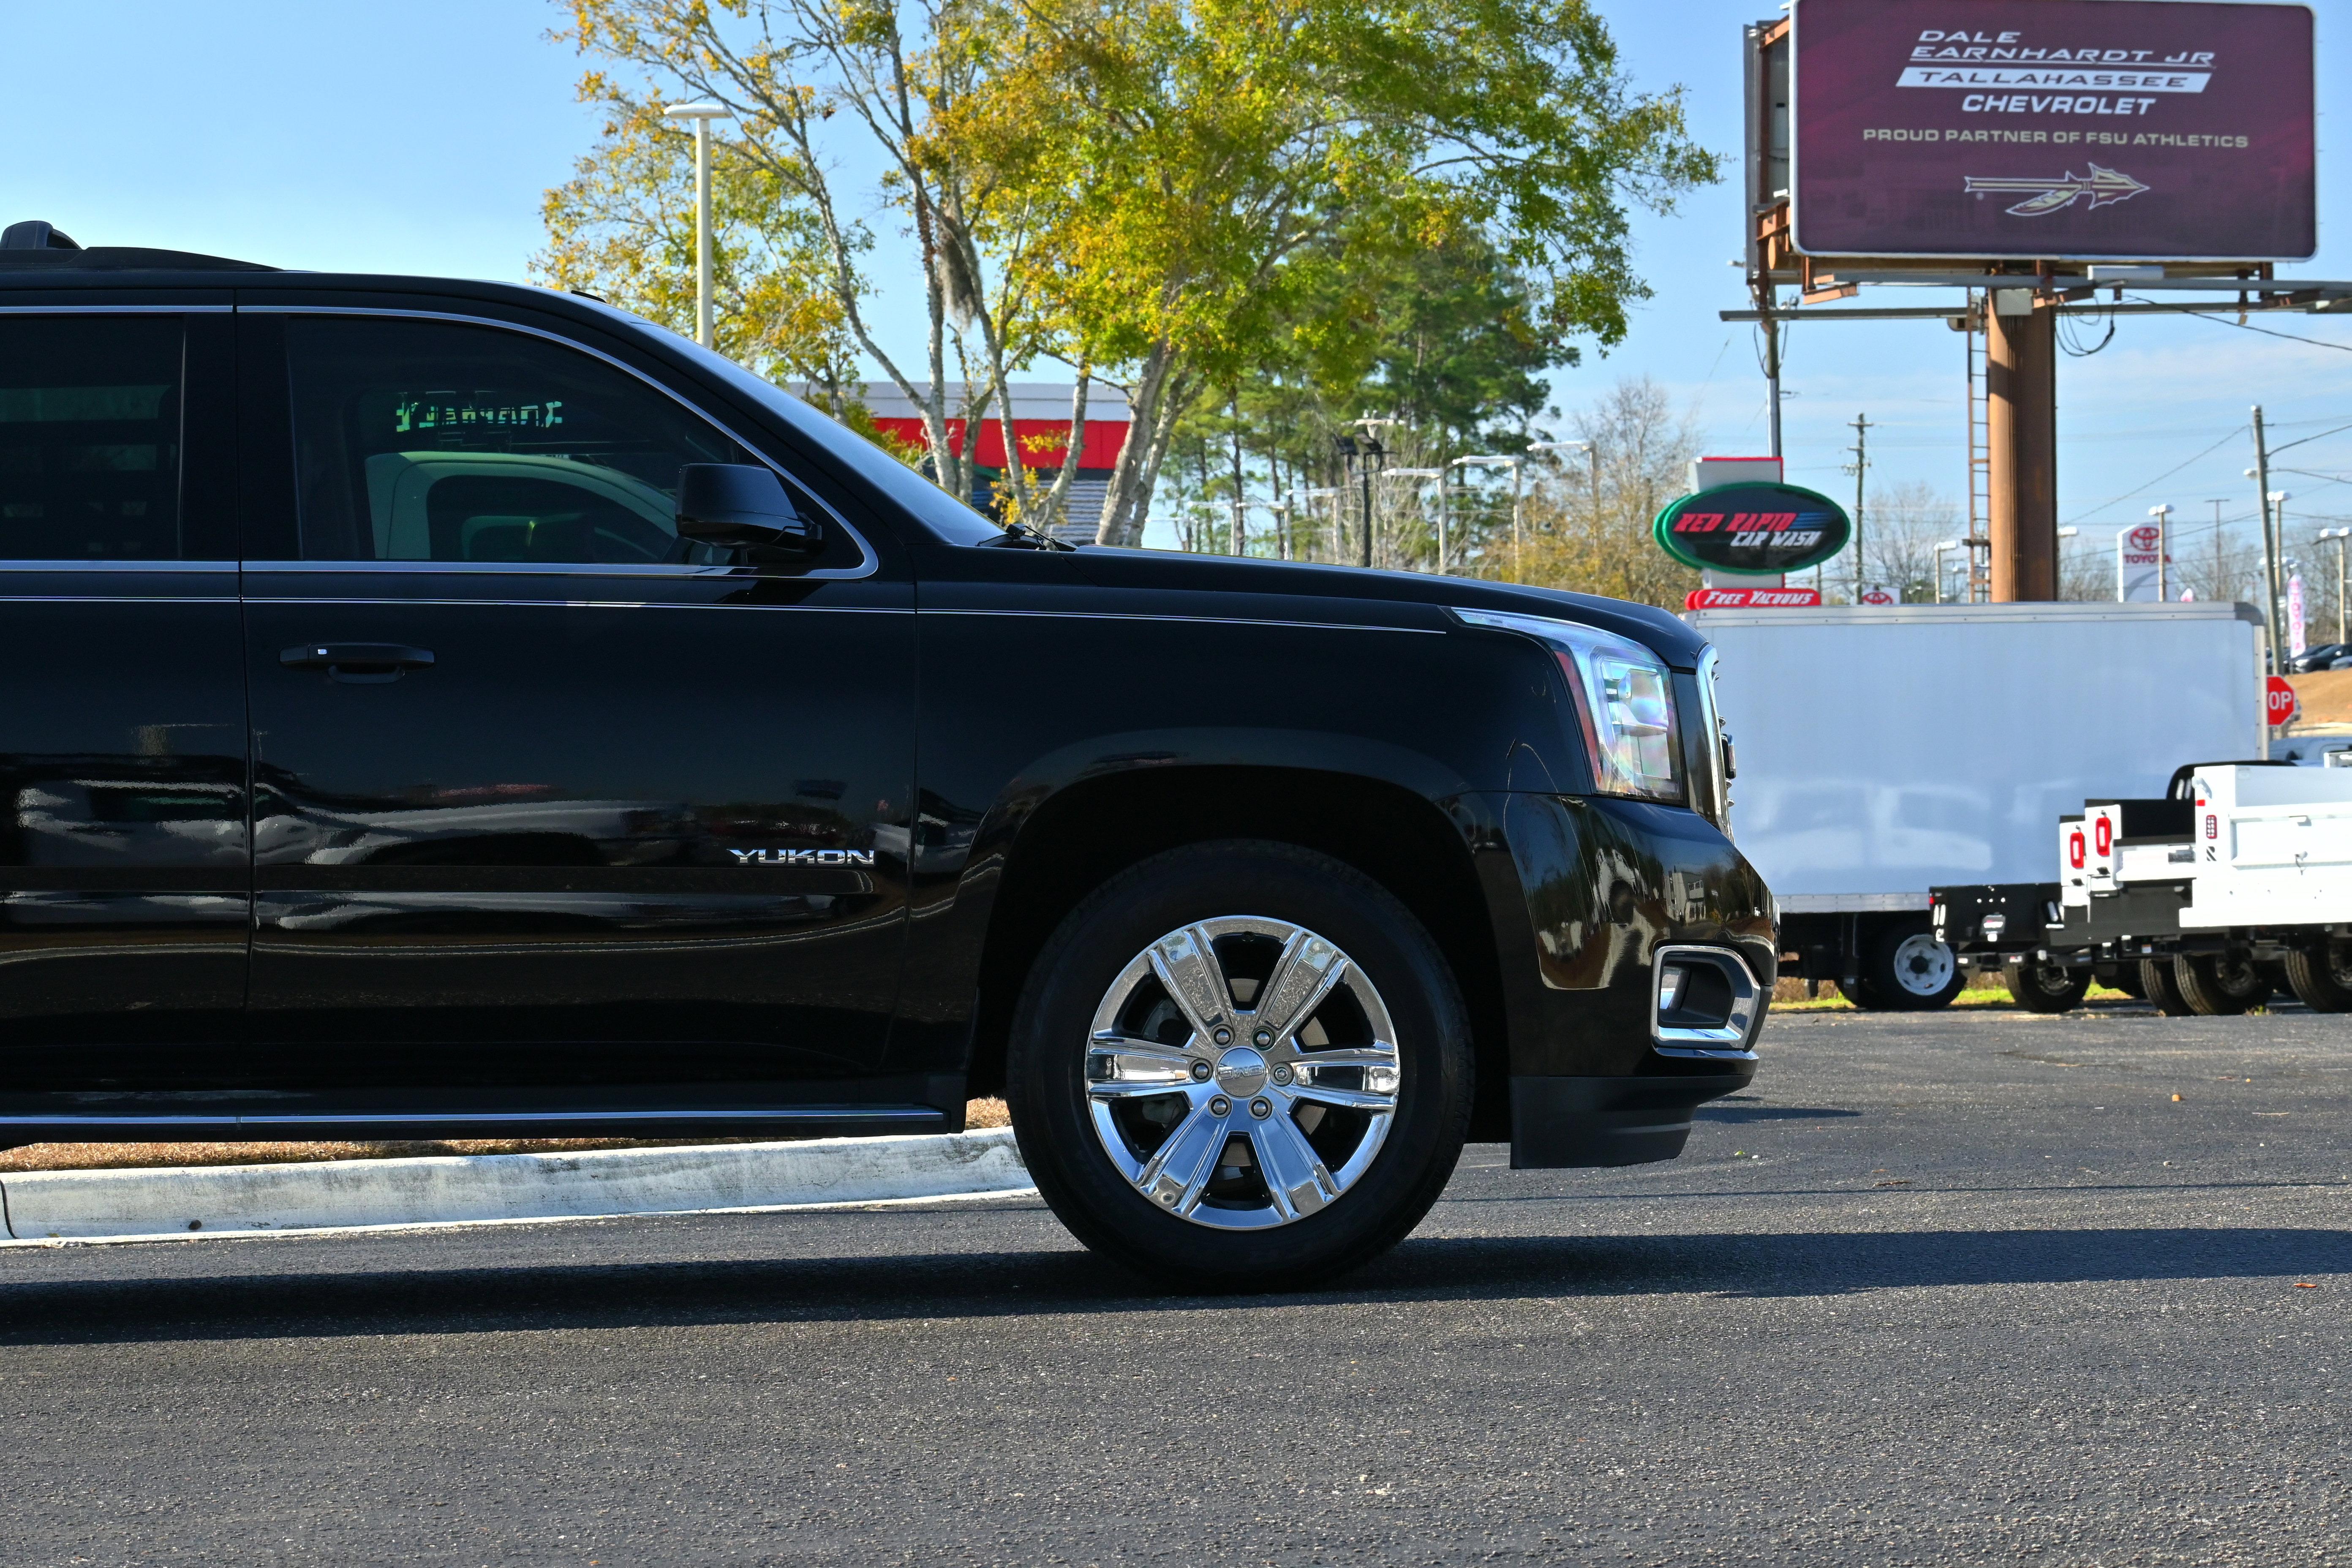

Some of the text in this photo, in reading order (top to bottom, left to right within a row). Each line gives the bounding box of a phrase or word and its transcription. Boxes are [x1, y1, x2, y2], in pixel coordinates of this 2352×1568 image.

[1919, 30, 2021, 44] DALE
[1911, 46, 2215, 67] EARNHARDT JR
[1919, 71, 2189, 87] TALLAHASSEE
[1962, 94, 2156, 115] CHEVROLET
[1863, 129, 2249, 148] PROUD PARTNER OF FSU ATHLETICS
[1673, 512, 1797, 532] RED RAPID
[1730, 531, 1822, 547] CAR WASH
[2267, 691, 2292, 710] OP
[726, 848, 875, 865] YUKON
[1218, 1065, 1263, 1081] GMC
